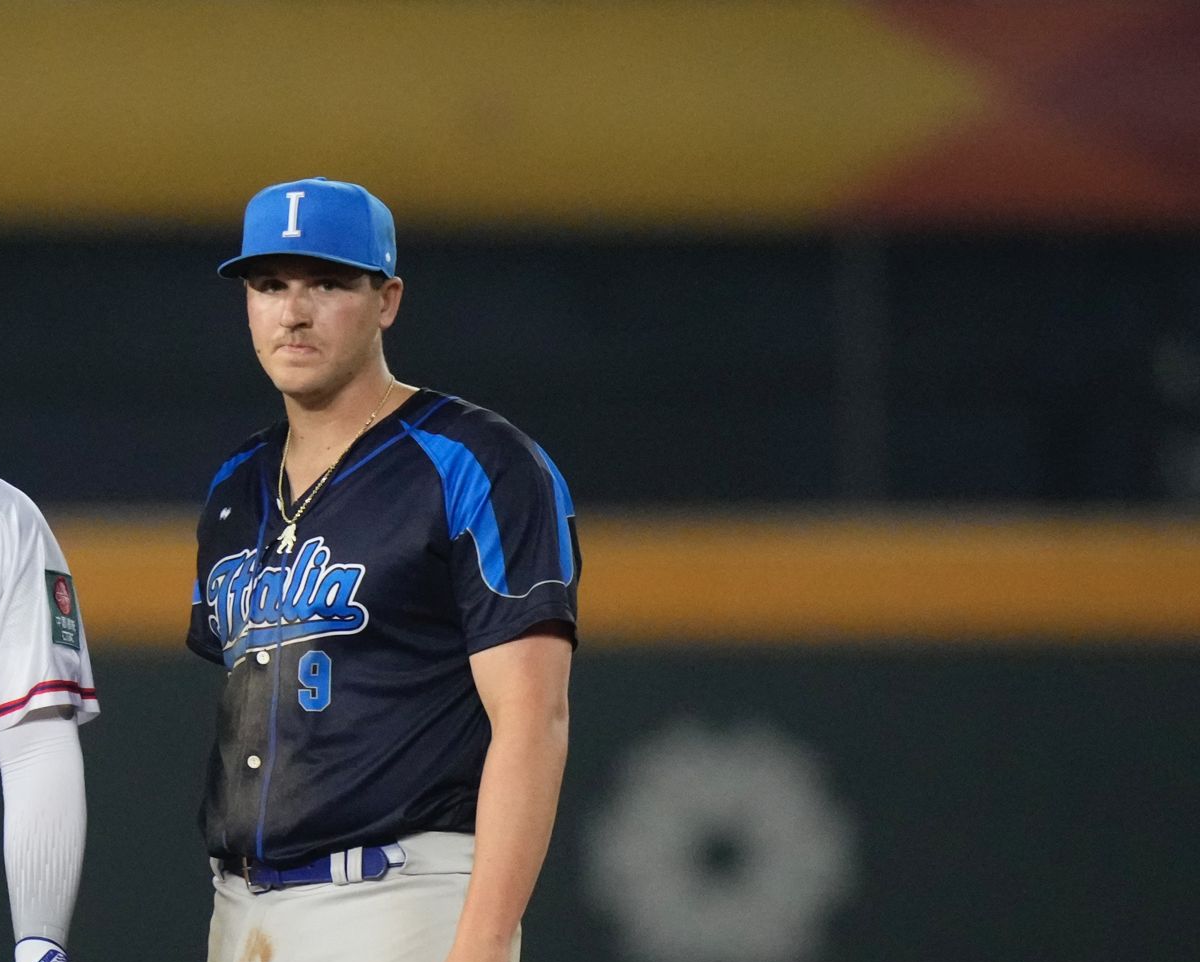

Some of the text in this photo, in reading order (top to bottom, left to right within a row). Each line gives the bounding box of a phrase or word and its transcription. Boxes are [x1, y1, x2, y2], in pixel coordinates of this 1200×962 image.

[282, 191, 305, 238] I
[207, 536, 368, 652] Italia
[298, 650, 331, 712] 9
